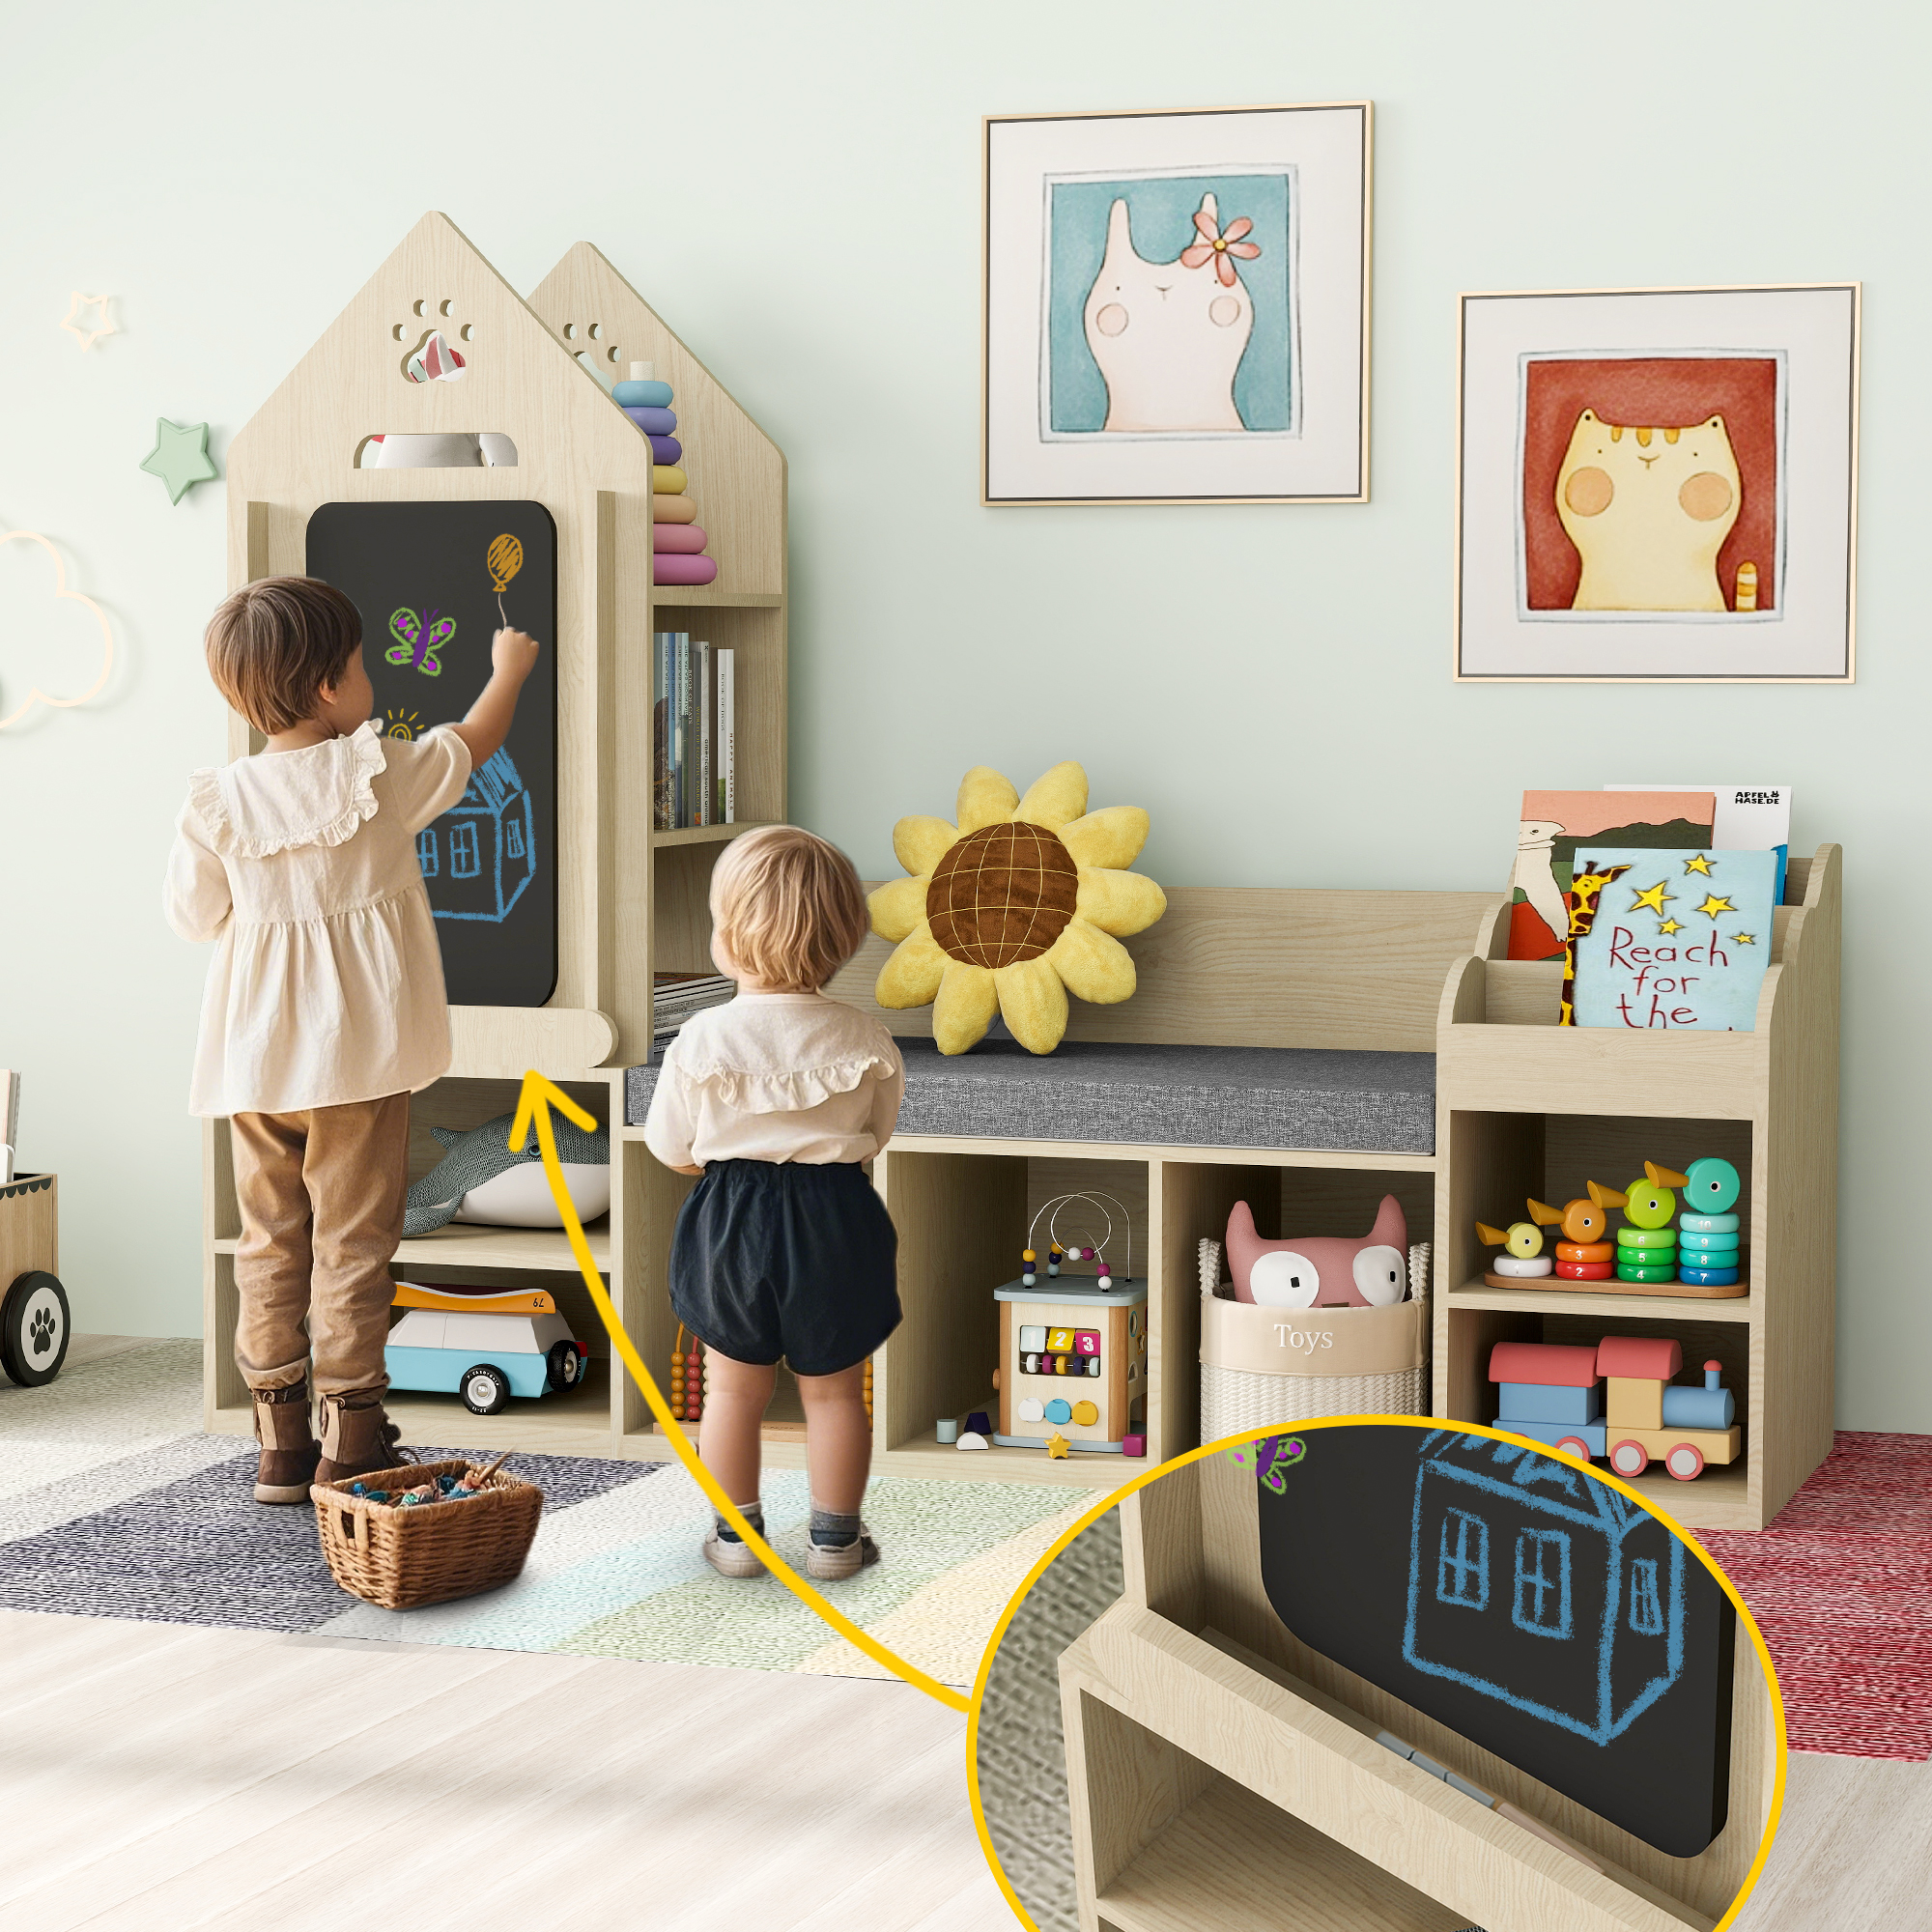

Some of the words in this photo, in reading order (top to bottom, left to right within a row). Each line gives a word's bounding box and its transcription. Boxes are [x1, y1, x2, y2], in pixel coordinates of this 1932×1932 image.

[1610, 926, 1727, 970] Reach
[1633, 966, 1700, 996] for
[1615, 993, 1697, 1029] the
[1697, 1220, 1712, 1231] 10
[1637, 1236, 1645, 1245] 6
[1700, 1238, 1708, 1247] 9
[1576, 1250, 1582, 1260] 3
[1638, 1253, 1646, 1263] 5
[1700, 1256, 1708, 1264] 8
[1514, 1264, 1520, 1274] 1
[1576, 1267, 1583, 1277] 2
[1636, 1270, 1644, 1280] 4
[1700, 1273, 1707, 1282] 7
[1029, 1331, 1036, 1348] 1
[1055, 1332, 1066, 1347] 2
[1083, 1337, 1094, 1351] 3
[1273, 1323, 1333, 1355] Toys
